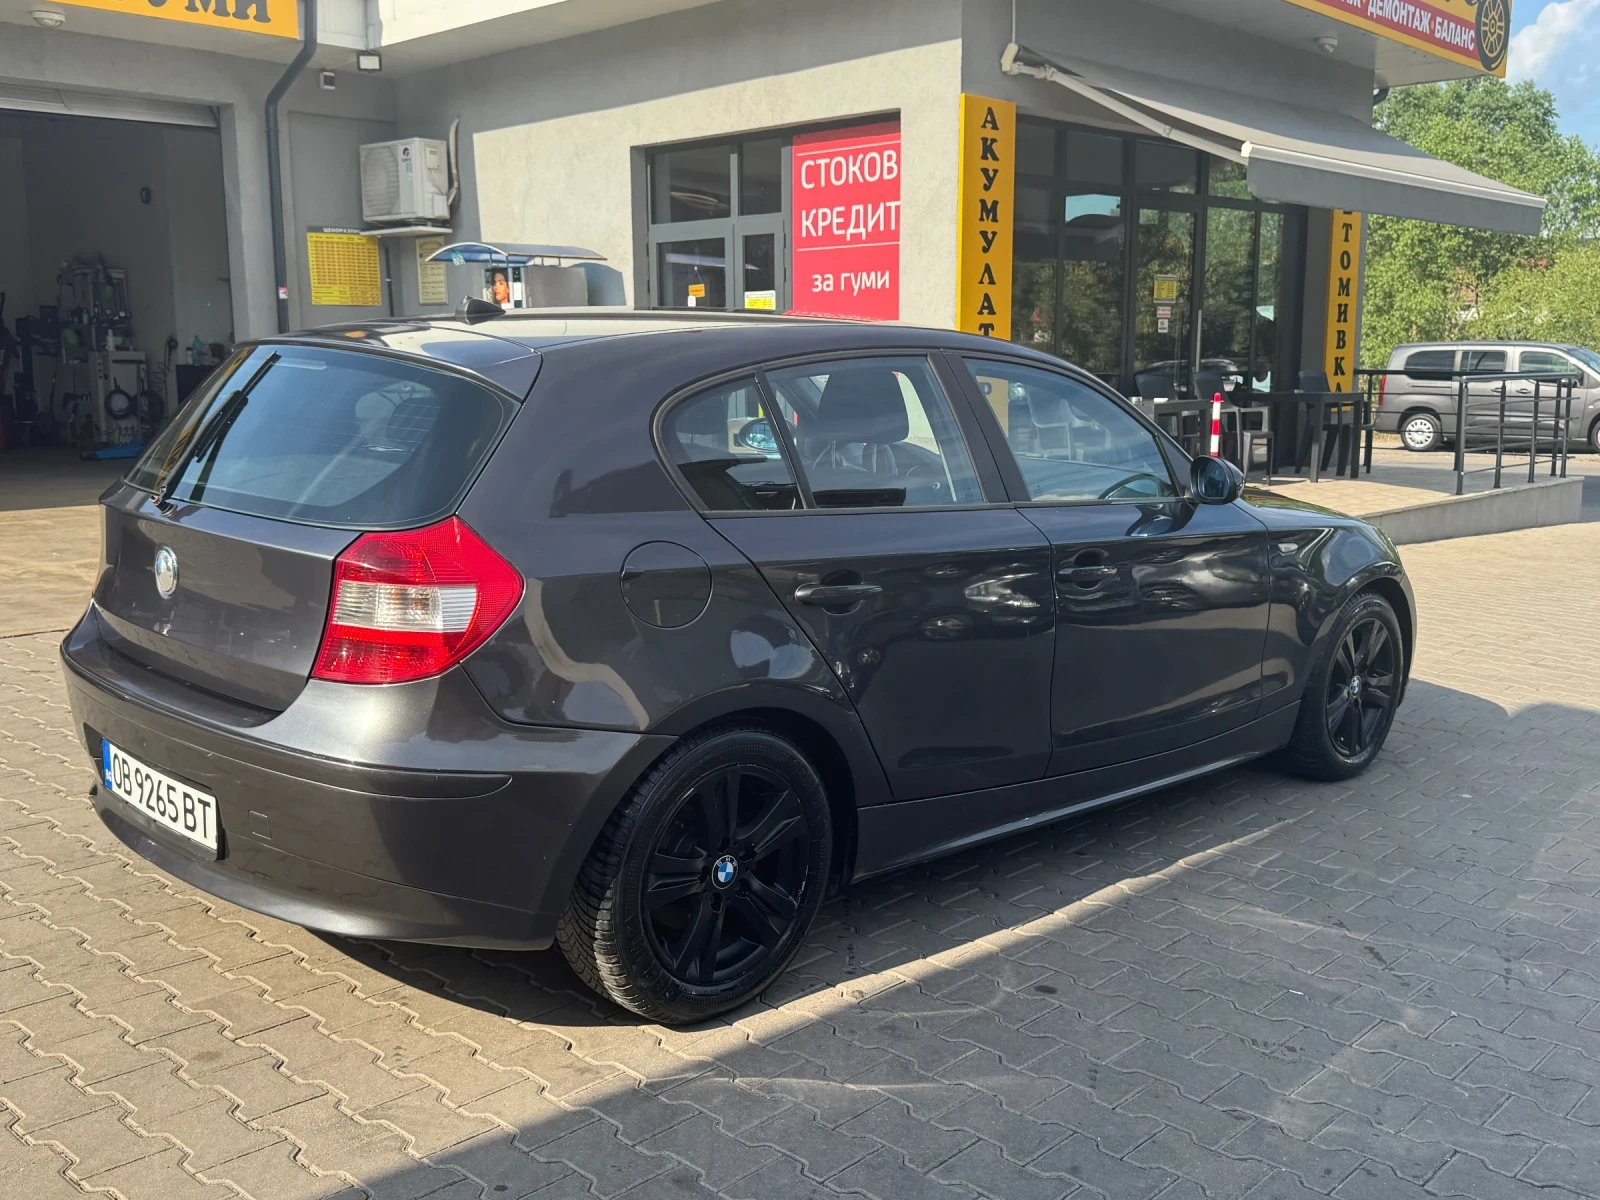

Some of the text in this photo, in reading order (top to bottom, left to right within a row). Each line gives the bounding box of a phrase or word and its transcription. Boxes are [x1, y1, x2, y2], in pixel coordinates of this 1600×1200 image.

[1367, 0, 1475, 51] ДЕМОНТАЖ БАЛАНС
[801, 150, 898, 189] СТОКОВ
[801, 201, 900, 241] КРЕДИТ
[812, 270, 890, 297] за гуми
[135, 767, 179, 823] 9265
[183, 791, 211, 839] BT
